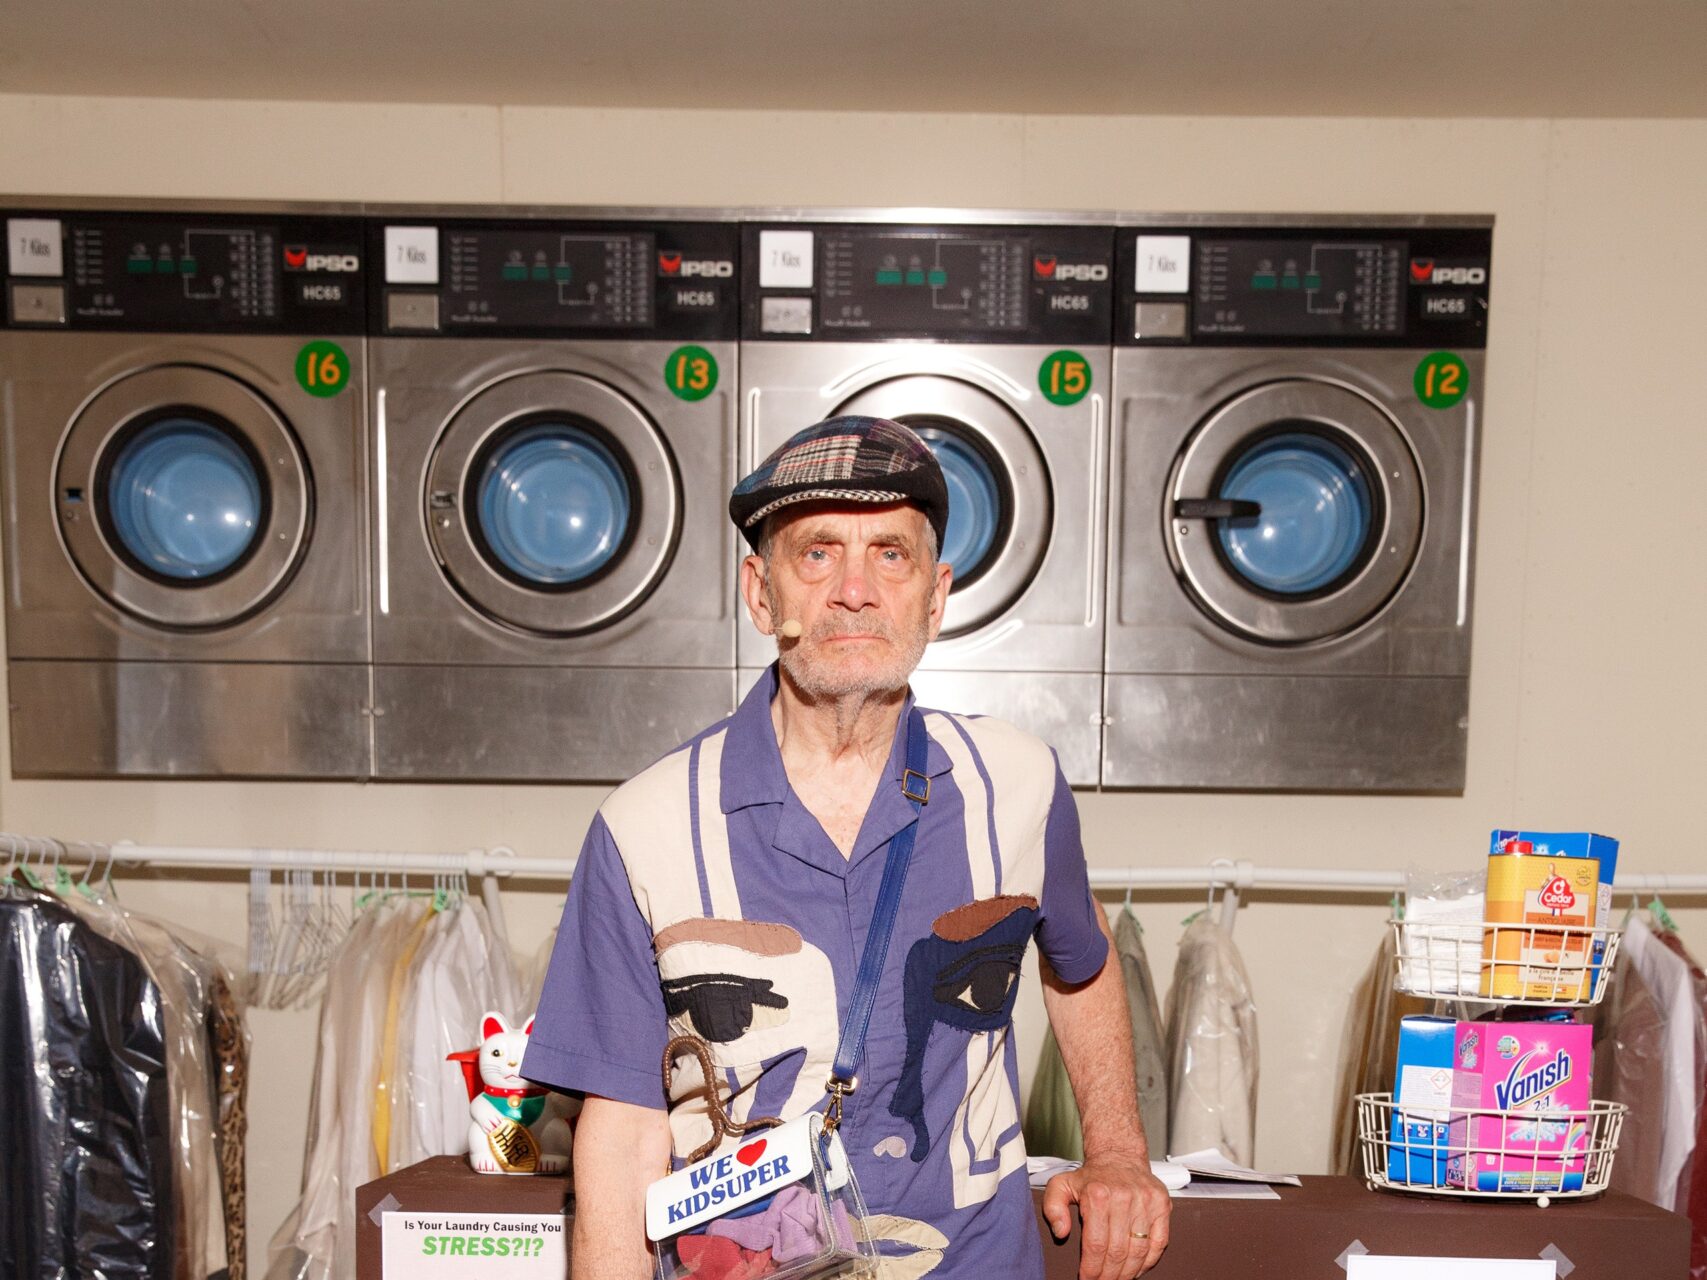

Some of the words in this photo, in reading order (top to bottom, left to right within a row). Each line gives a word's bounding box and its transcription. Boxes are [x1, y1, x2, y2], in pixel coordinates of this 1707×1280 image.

[306, 256, 359, 272] IPSO
[681, 261, 733, 277] IPSO
[1055, 265, 1109, 281] IPSO
[1432, 267, 1486, 284] IPSO
[304, 287, 341, 301] HC65
[677, 291, 714, 306] HC65
[1051, 295, 1089, 310] HC65
[1427, 298, 1466, 313] HC65
[306, 352, 341, 386] 16
[676, 354, 710, 391] 13
[1050, 360, 1086, 396] 15
[1424, 363, 1460, 397] 12
[1544, 893, 1572, 903] Cedar
[1496, 1049, 1571, 1110] Vanish
[689, 1154, 733, 1189] WE
[667, 1155, 791, 1224] KIDSUPER
[404, 1220, 414, 1230] Is
[417, 1221, 442, 1231] Your
[445, 1221, 489, 1234] Laundry
[493, 1222, 538, 1235] Causing
[541, 1223, 561, 1233] You
